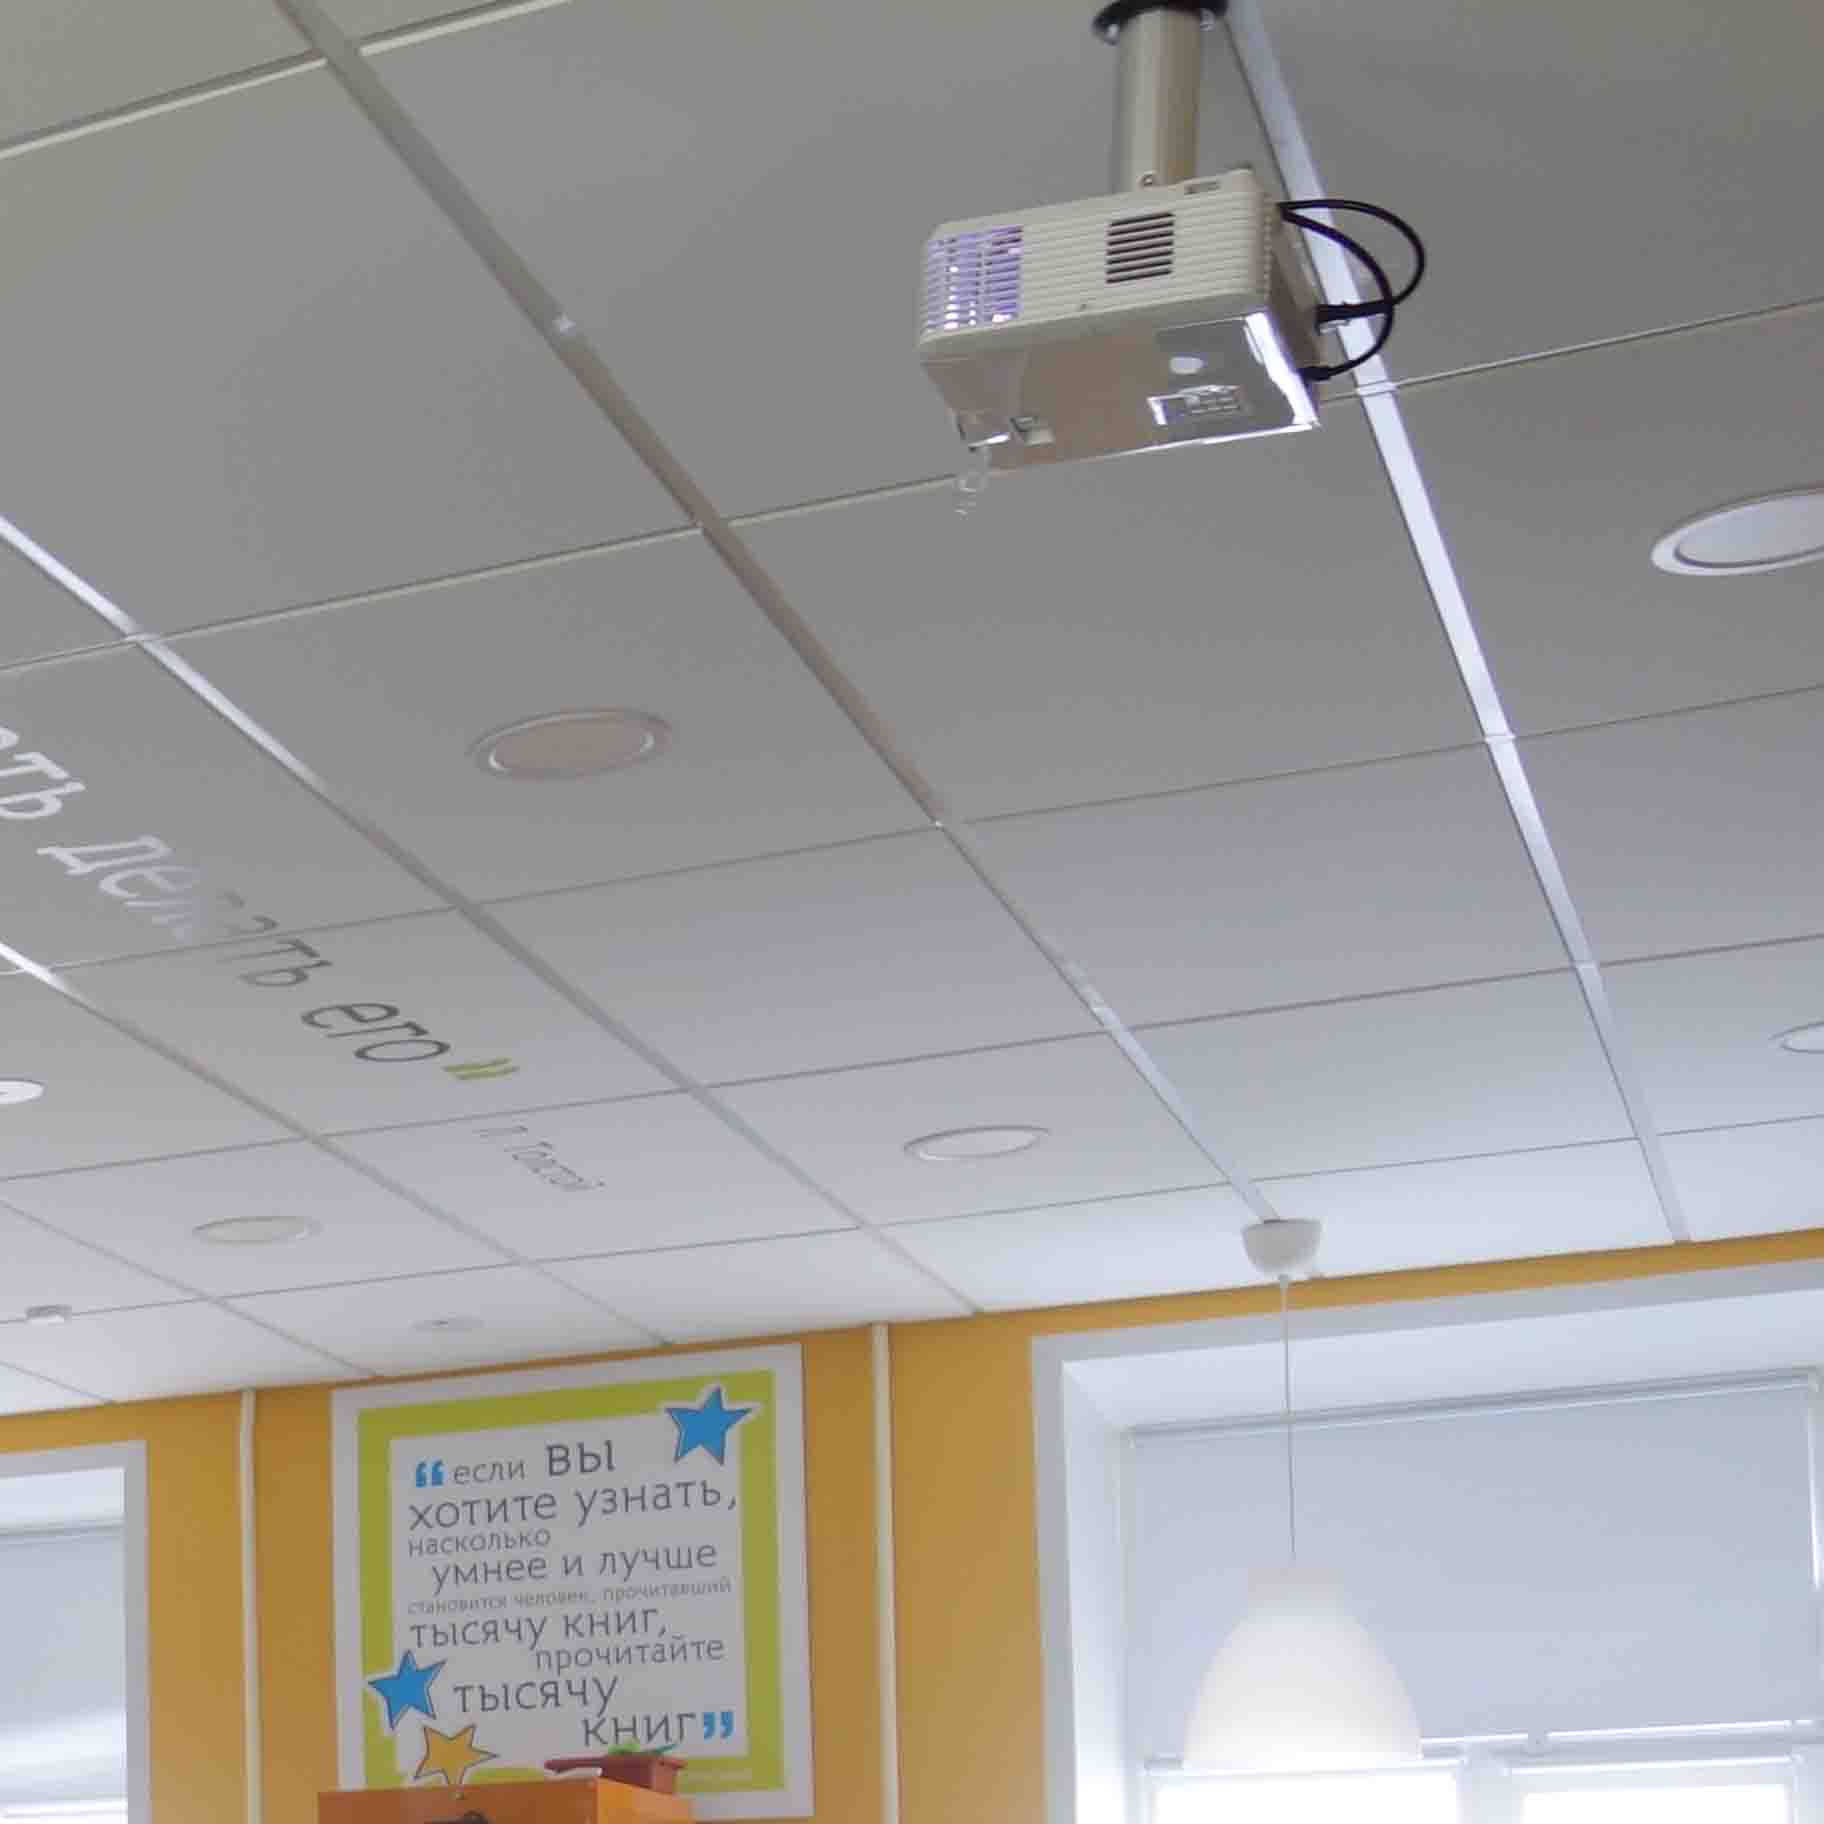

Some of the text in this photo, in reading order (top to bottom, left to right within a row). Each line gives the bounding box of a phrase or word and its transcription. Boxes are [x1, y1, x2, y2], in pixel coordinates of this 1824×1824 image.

[409, 1480, 737, 1531] хотите узнать,
[408, 1528, 552, 1558] насколько
[432, 1544, 717, 1595] умнее и лучше
[409, 1607, 667, 1650] тысячу книг,
[534, 1635, 725, 1675] прочитайте
[453, 1676, 619, 1714] тысячу
